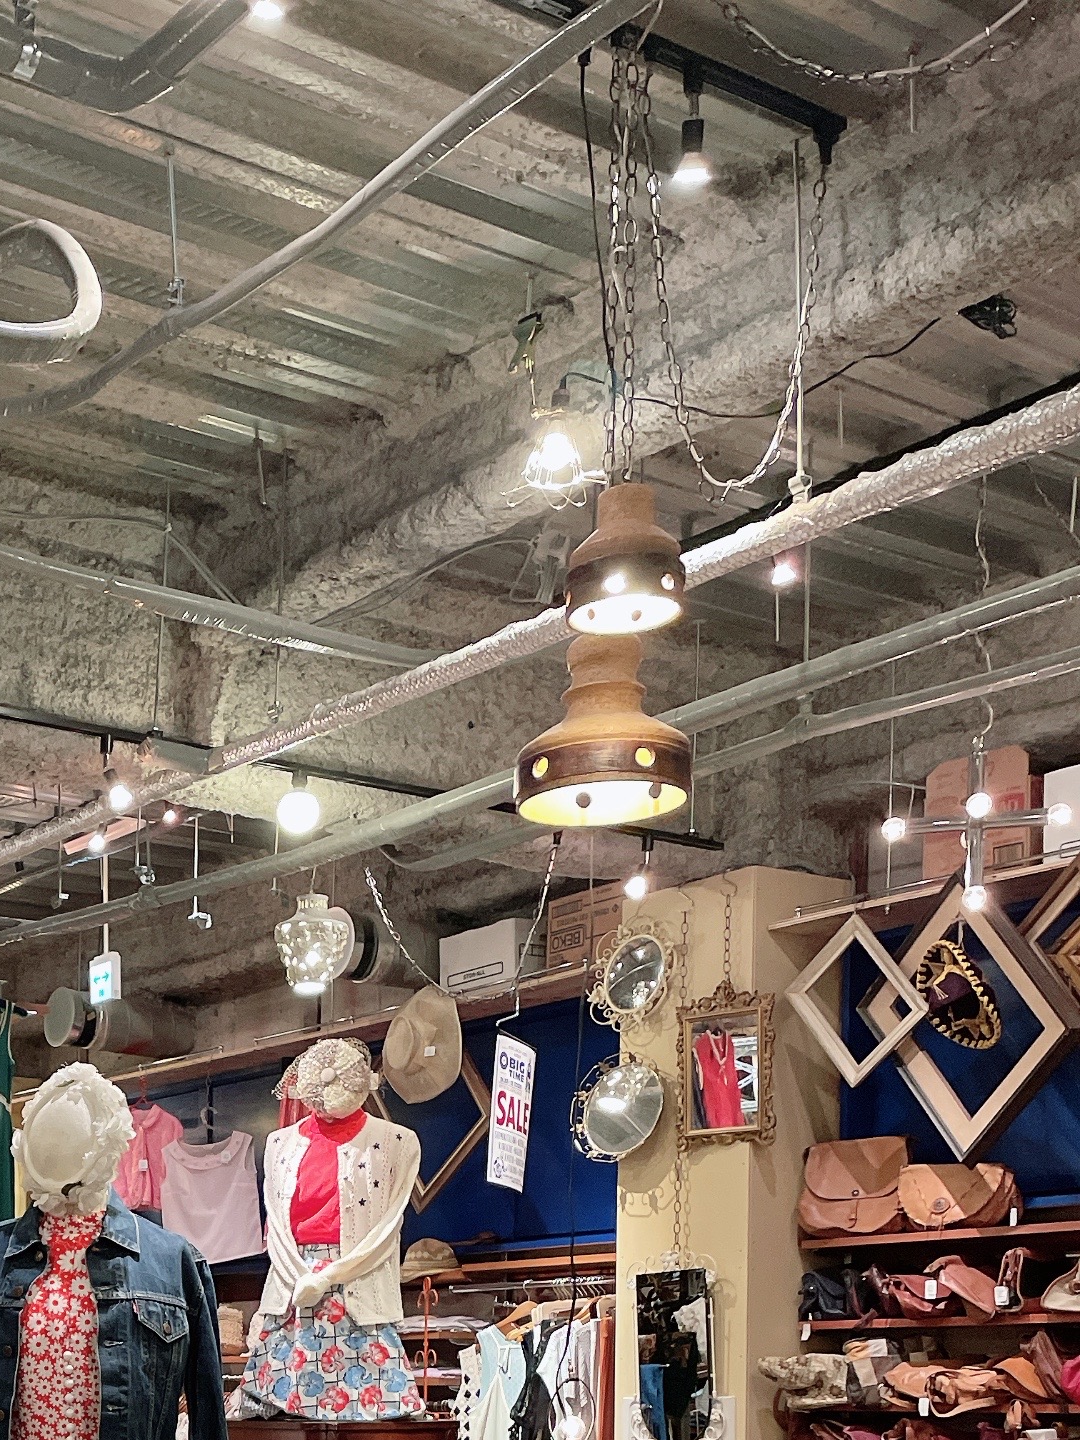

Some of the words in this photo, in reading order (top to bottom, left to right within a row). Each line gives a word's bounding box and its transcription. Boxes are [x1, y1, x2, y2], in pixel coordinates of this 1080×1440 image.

[552, 931, 581, 950] BEKO
[509, 1056, 525, 1074] BIG
[509, 1069, 525, 1083] TIME
[496, 1090, 529, 1136] SALE
